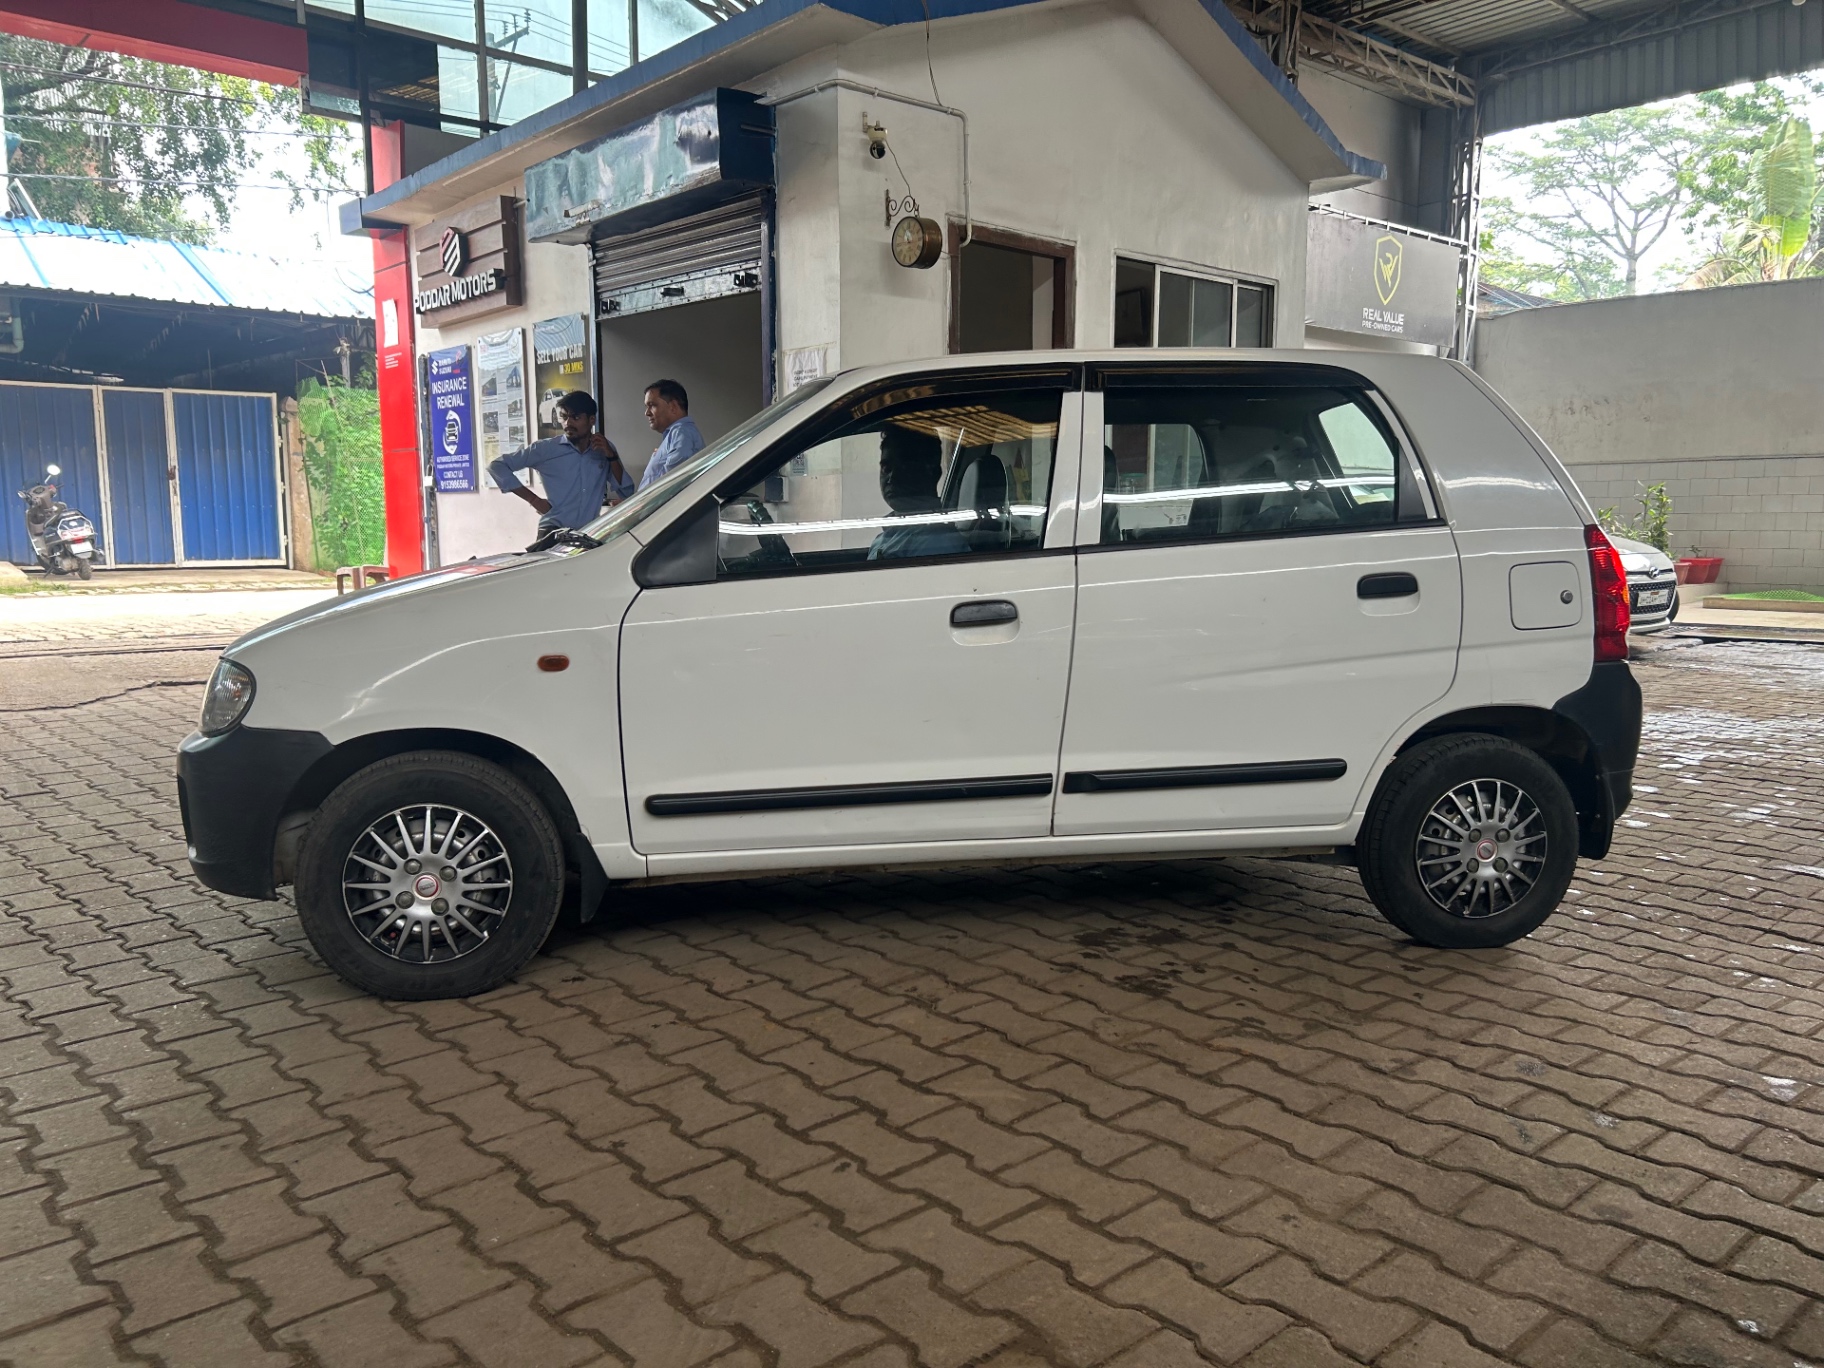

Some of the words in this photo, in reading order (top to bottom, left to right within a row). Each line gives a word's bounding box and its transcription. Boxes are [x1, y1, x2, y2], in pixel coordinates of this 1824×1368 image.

[414, 284, 451, 312] PODDAR
[451, 268, 496, 302] MOTORS
[1362, 307, 1382, 322] REAL
[1383, 311, 1405, 326] VALUE
[1362, 320, 1391, 332] PRE-OWNED
[1391, 325, 1404, 334] CARS
[537, 349, 550, 365] SELL
[552, 346, 567, 362] YOUR
[569, 343, 583, 359] CAR
[564, 362, 571, 375] 30
[431, 376, 467, 395] INSURANCE
[436, 393, 465, 410] RENEWAL
[443, 470, 458, 479] CONTACT
